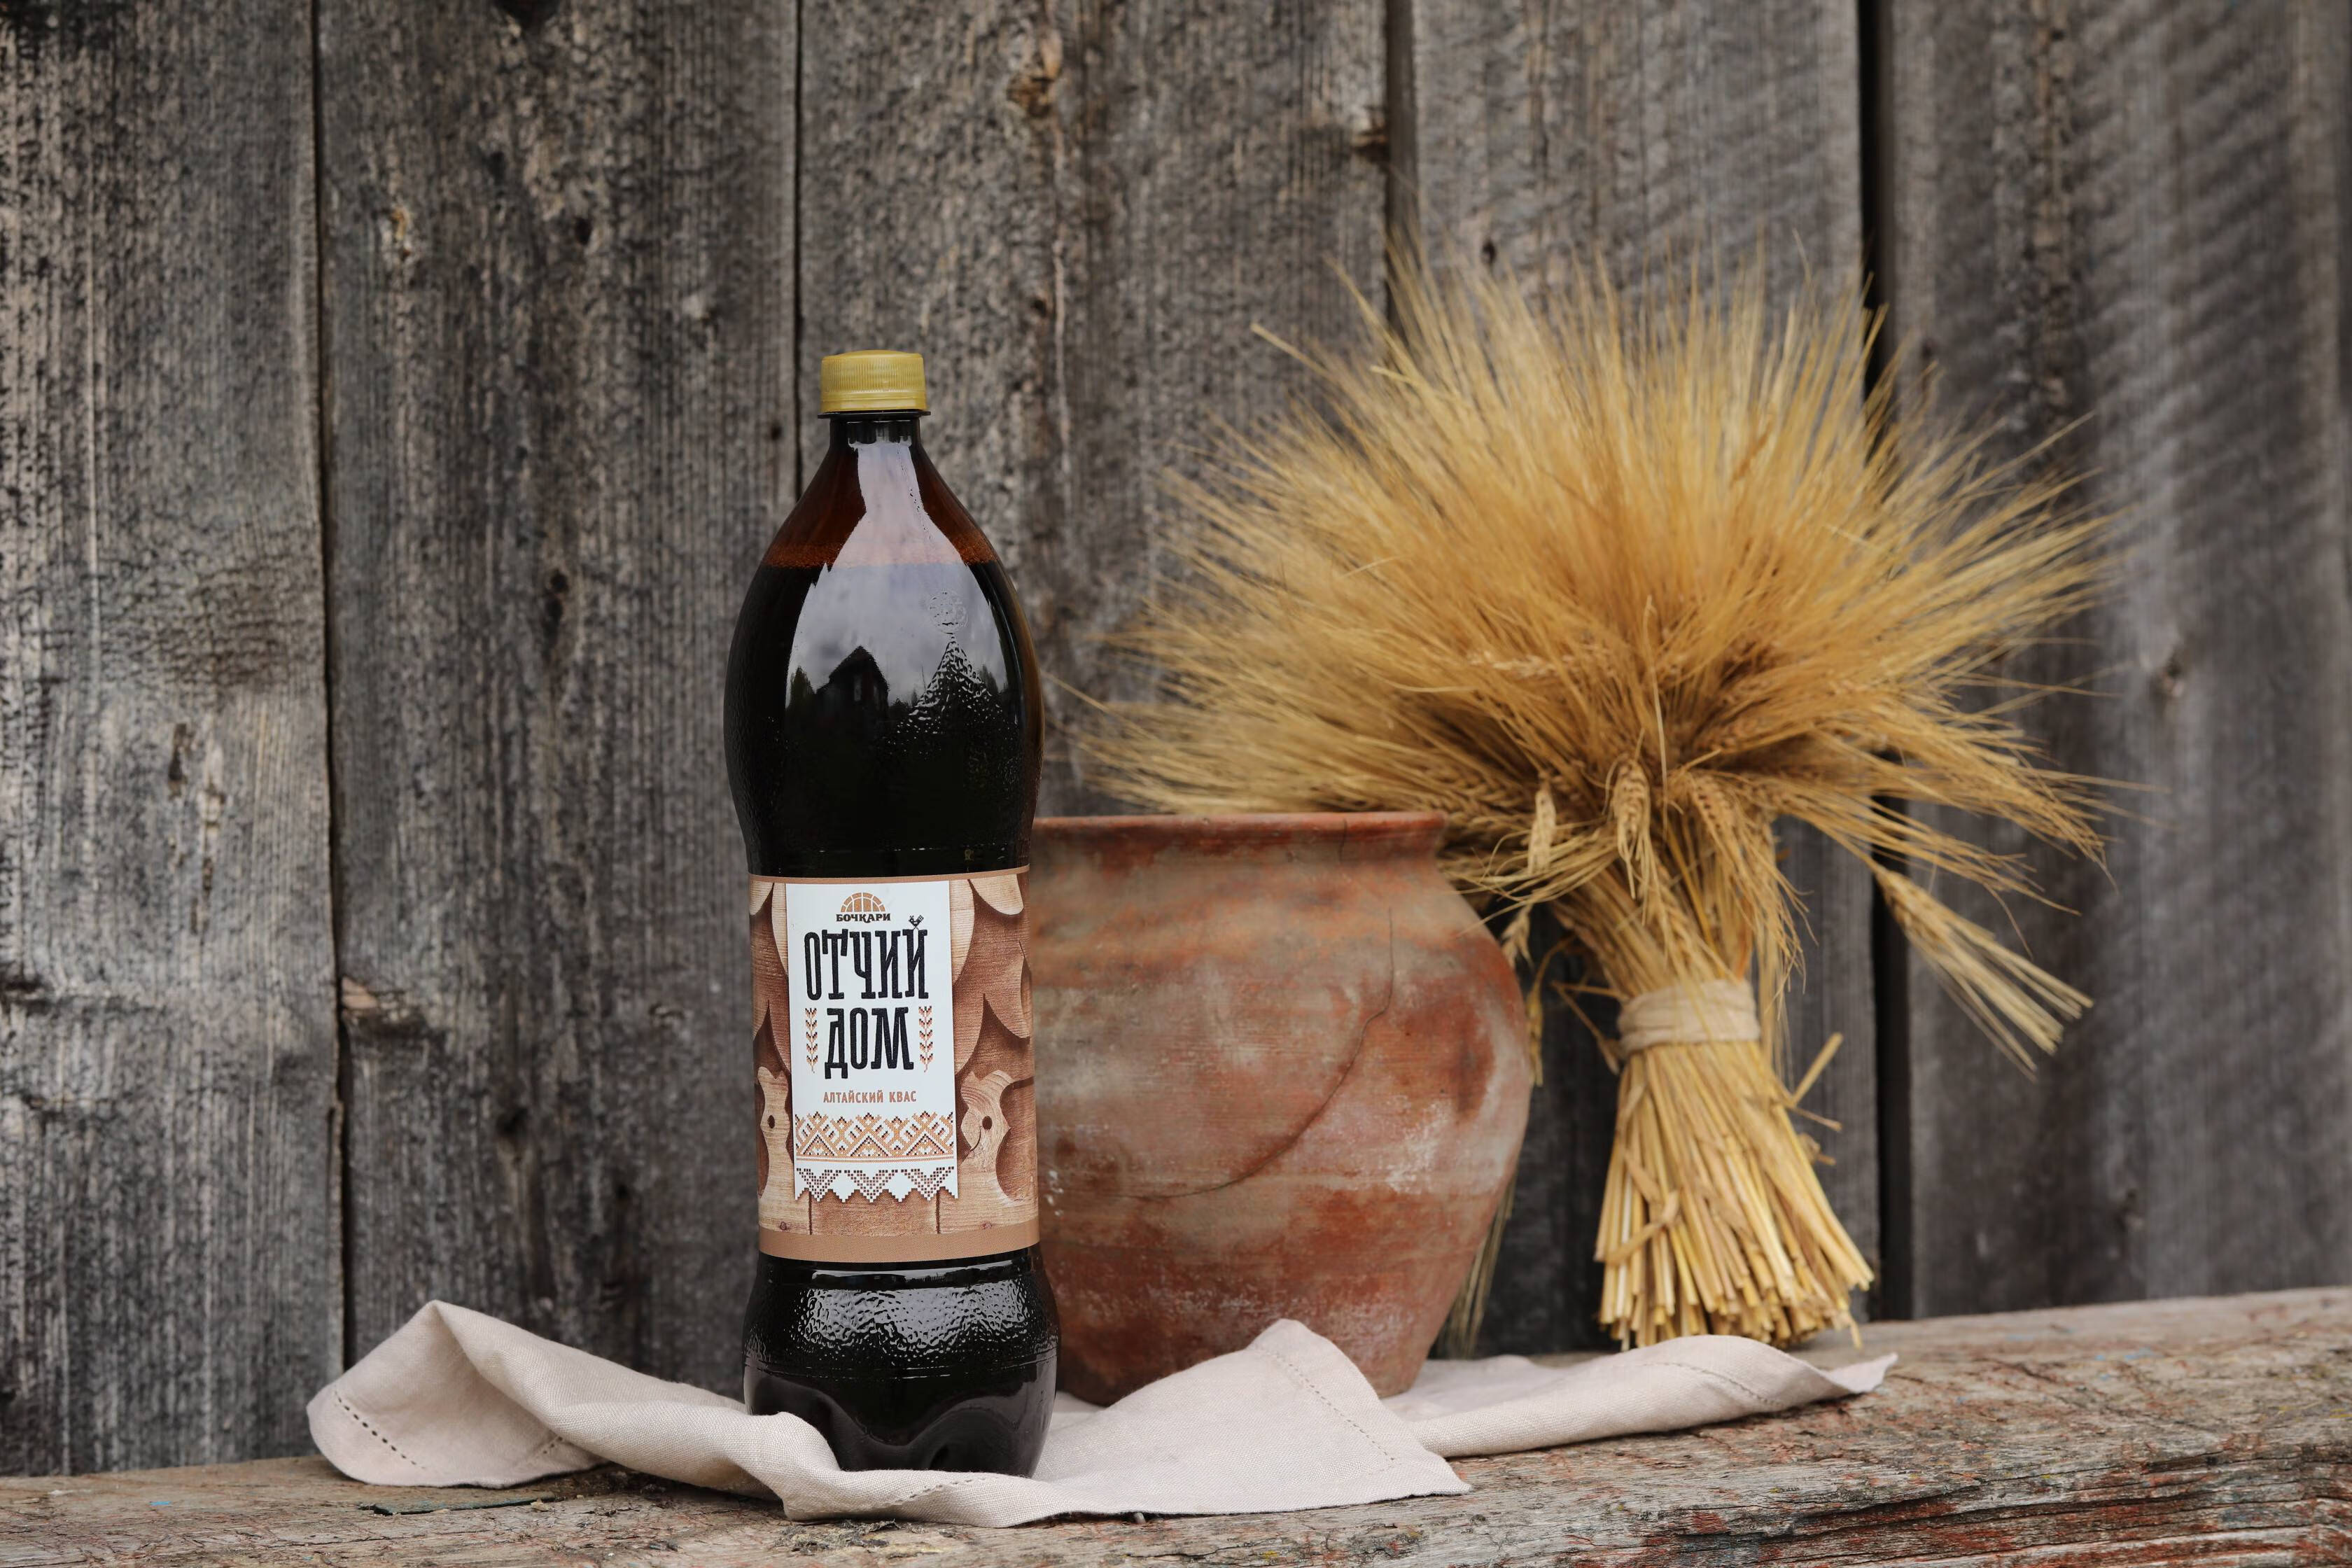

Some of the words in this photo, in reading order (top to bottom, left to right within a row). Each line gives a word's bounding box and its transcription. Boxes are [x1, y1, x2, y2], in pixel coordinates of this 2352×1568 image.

[836, 913, 891, 923] БОЧКАРИ
[804, 915, 930, 1001] ОТЧИЙ
[824, 1007, 914, 1079] ДОМ
[822, 1089, 884, 1104] АЛТАЙСКИЙ
[888, 1090, 917, 1103] КВАС
